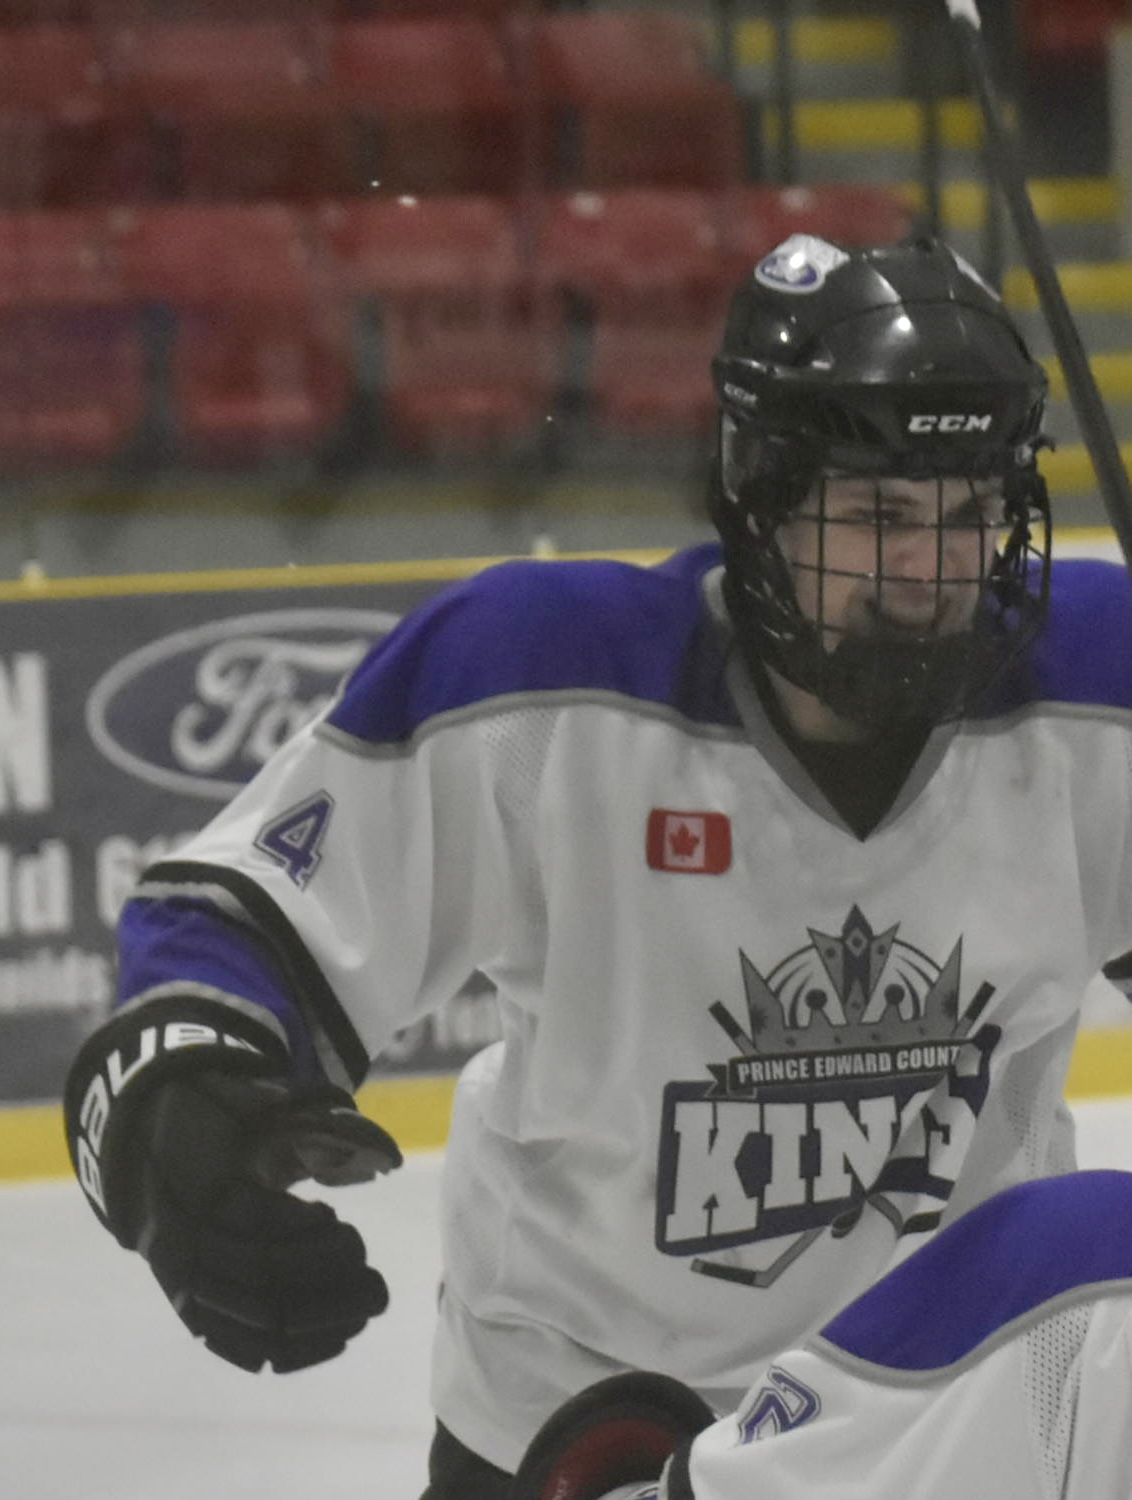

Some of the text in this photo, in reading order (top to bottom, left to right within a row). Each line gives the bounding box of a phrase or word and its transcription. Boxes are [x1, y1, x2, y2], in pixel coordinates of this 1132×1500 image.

[908, 413, 993, 434] CCM
[253, 789, 335, 892] 4
[737, 1045, 961, 1084] PRINCE EDWARD COUNT
